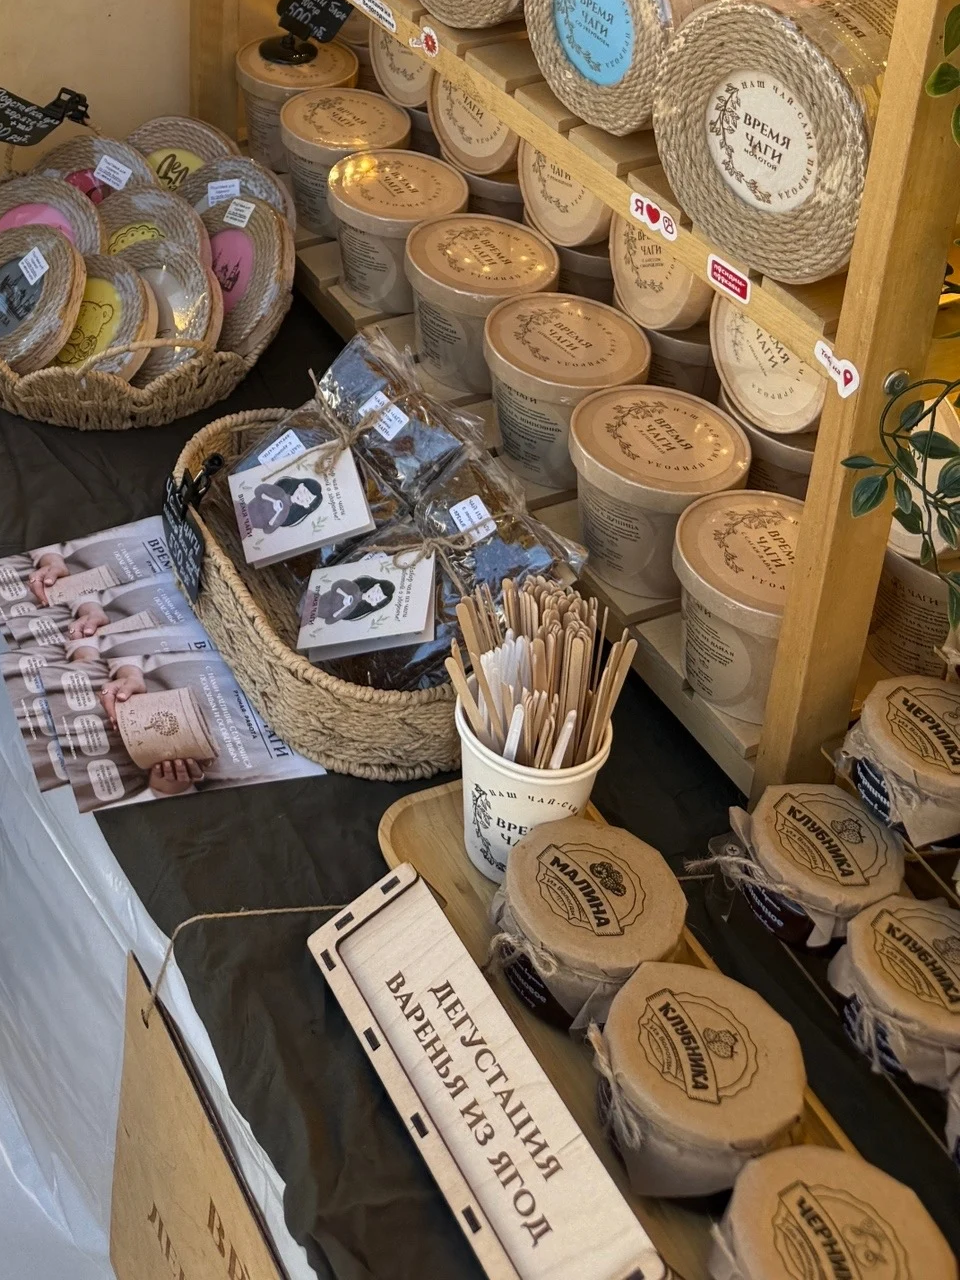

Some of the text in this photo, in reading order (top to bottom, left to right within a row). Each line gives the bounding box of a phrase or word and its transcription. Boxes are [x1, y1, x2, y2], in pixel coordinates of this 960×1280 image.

[581, 10, 609, 38] ЧАГИ
[741, 80, 766, 90] НАШ
[778, 158, 814, 200] ПРИРОДА
[743, 112, 791, 150] ВРЕМЯ
[745, 131, 783, 165] ЧАГИ
[743, 146, 778, 173] МОЛОТОЙ
[472, 244, 497, 266] ЧАГИ
[480, 239, 513, 265] ВРЕМЯ
[640, 244, 662, 256] ЧАГИ
[548, 328, 579, 352] ЧАГИ
[553, 321, 593, 349] ВРЕМЯ
[756, 328, 779, 369] ЧАГИ
[646, 423, 678, 453] ЧАГИ
[653, 417, 694, 451] ВРЕМЯ
[647, 459, 705, 471] ПРИРОДА
[756, 536, 786, 569] ЧАГИ
[767, 529, 797, 565] ВРЕМ
[230, 689, 259, 739] РУЧНАЯ РАБОТА
[260, 722, 289, 760] АГИ
[496, 817, 534, 837] ВРЕ
[786, 804, 855, 878] КЛУБНИКА
[549, 855, 611, 927] МАЛИНА
[658, 1001, 709, 1090] КЛУБНИКА
[427, 979, 564, 1182] ДЕГУСТАЦИЯ
[384, 970, 553, 1249] ВАРЕНЬЯ ИЗ ЯГОД
